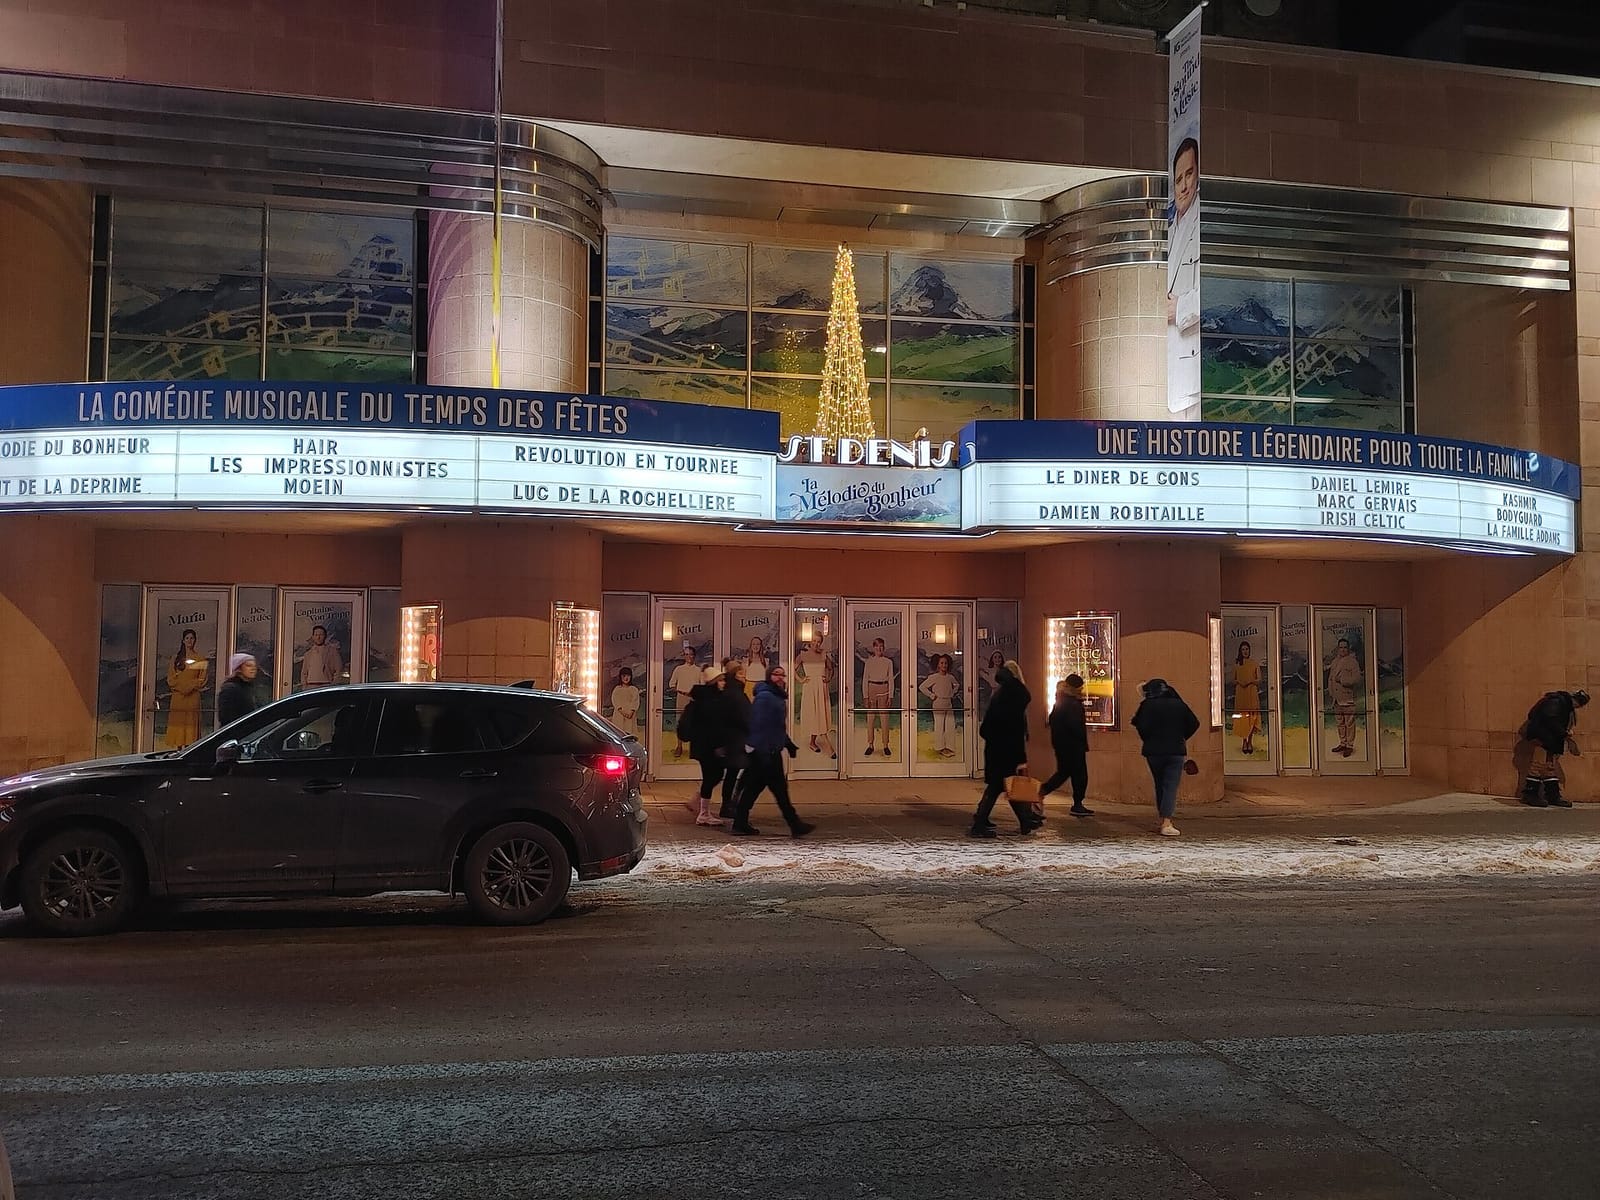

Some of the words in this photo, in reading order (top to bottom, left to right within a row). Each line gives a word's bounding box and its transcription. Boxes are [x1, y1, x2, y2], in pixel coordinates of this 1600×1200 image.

[79, 392, 104, 422] LA
[113, 384, 214, 421] COMÉDIE
[225, 390, 349, 422] MUSICALE
[360, 392, 393, 422] DU
[404, 393, 487, 427] TEMPS
[499, 398, 544, 429] DES
[555, 395, 629, 435] FÊTES
[2, 440, 36, 457] ODIE
[44, 439, 63, 455] DU
[72, 438, 150, 456] BONHEUR
[293, 438, 338, 455] HAIR
[777, 435, 829, 463] ST
[838, 438, 956, 468] DENIS
[1096, 428, 1139, 455] UNE
[1147, 428, 1243, 457] HISTOIRE
[1252, 427, 1362, 464] LÉGENDAIRE
[1369, 439, 1412, 467] POUR
[1418, 443, 1463, 472] TOUTE
[1467, 450, 1483, 475] LA
[1488, 452, 1531, 482] FAMILLE
[210, 457, 243, 473] LES
[264, 457, 449, 478] IMPRESSIONNISTES
[515, 445, 627, 468] REVOLUTION
[636, 453, 656, 469] EN
[665, 455, 739, 475] TOURNEE
[0, 480, 11, 495] T
[19, 479, 36, 495] DE
[45, 478, 62, 495] LA
[70, 477, 142, 495] DEPRIME
[284, 478, 343, 495] MOEIN
[801, 478, 818, 493] La
[1046, 470, 1065, 484] LE
[1074, 470, 1120, 485] DINER
[1130, 470, 1148, 485] DE
[1311, 476, 1358, 492] DANIEL
[1366, 479, 1410, 496] LEMIRE
[513, 484, 549, 500] LUC
[559, 486, 580, 502] DE
[589, 488, 610, 504] LA
[620, 489, 736, 511] ROCHELLIERE
[789, 482, 870, 512] Mélodie
[871, 481, 885, 494] du
[864, 478, 942, 515] Bonheur
[1318, 494, 1355, 509] MARC
[1365, 497, 1417, 513] GERVAIS
[1503, 493, 1537, 511] KASHMIR
[1039, 505, 1100, 520] DAMIEN
[1110, 506, 1205, 521] ROBITAILLE
[1321, 511, 1356, 526] IRISH
[1364, 513, 1405, 529] CELTIC
[1497, 508, 1543, 527] BODYGUARD
[1488, 523, 1498, 536] LA
[1502, 525, 1534, 541] FAMILLE
[169, 612, 206, 626] Maria
[740, 616, 769, 628] Luisa
[857, 616, 898, 631] Friedrich
[610, 629, 640, 642] Gretl
[676, 623, 702, 636] Kurt
[1230, 626, 1258, 639] Maria
